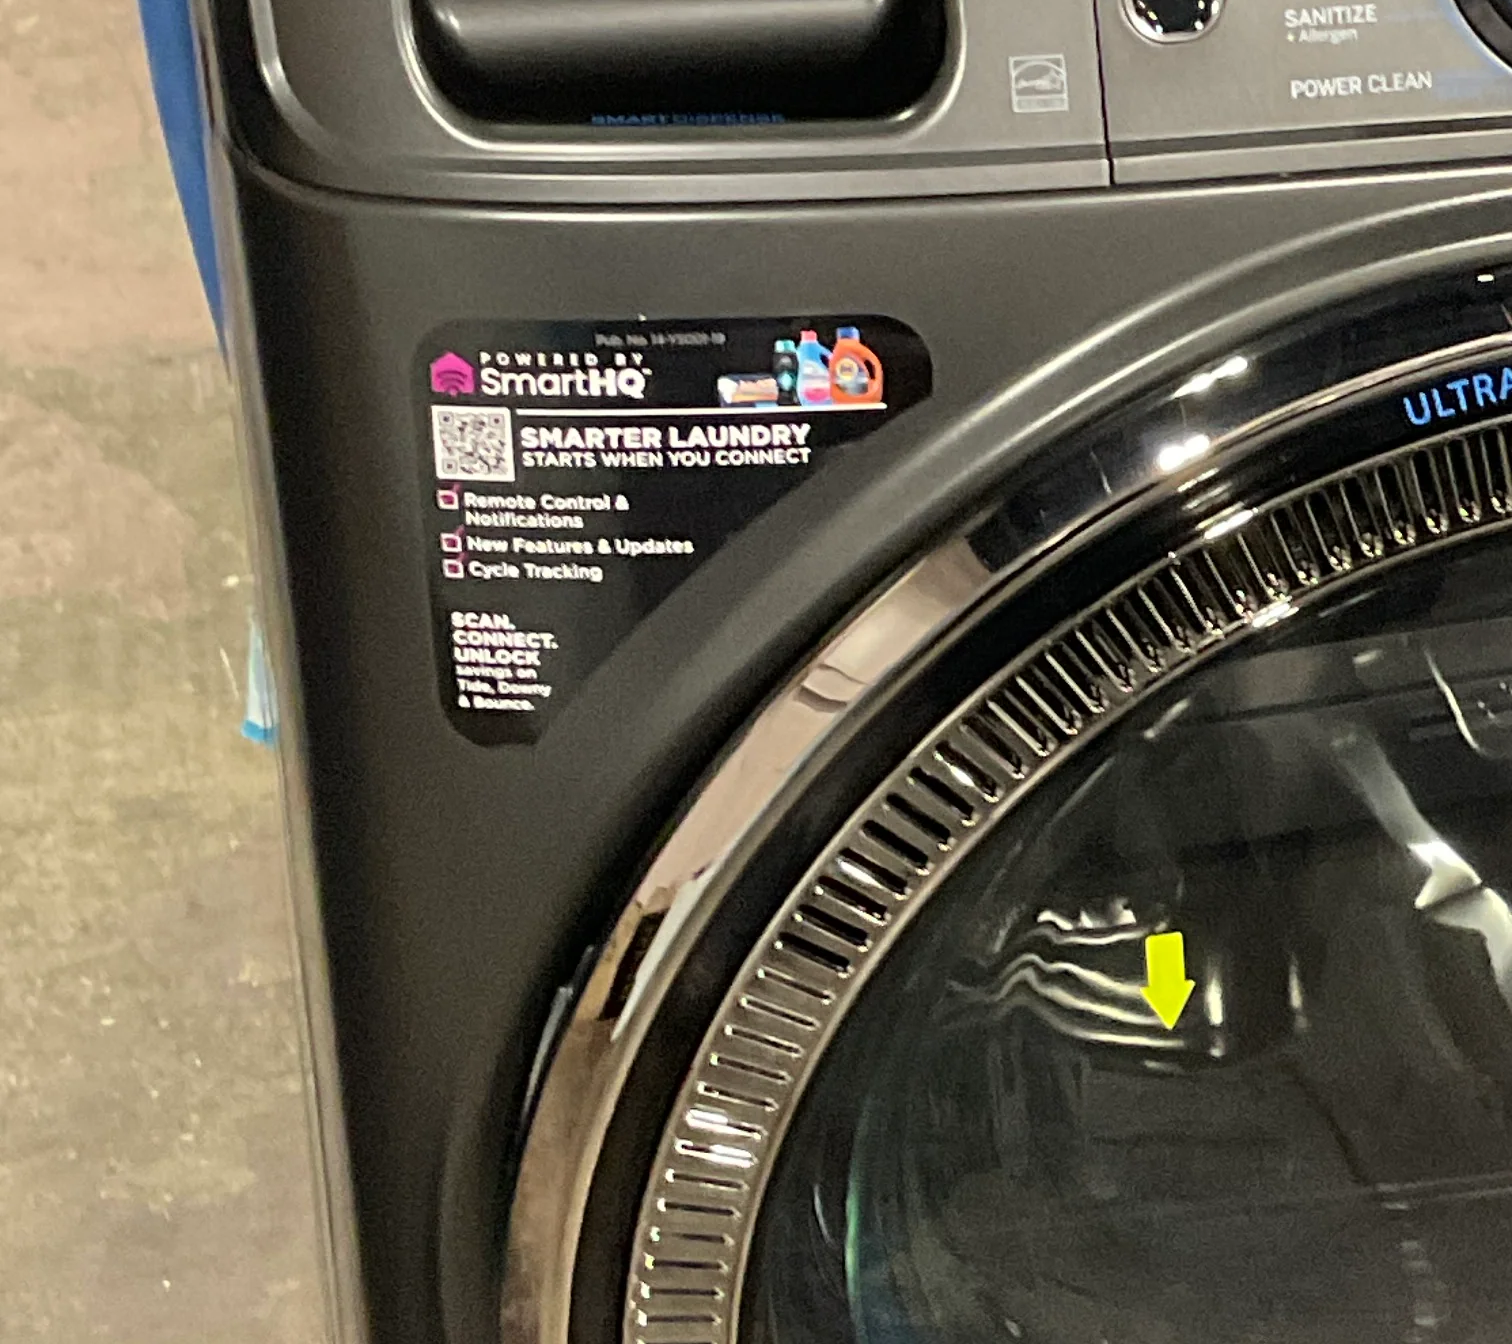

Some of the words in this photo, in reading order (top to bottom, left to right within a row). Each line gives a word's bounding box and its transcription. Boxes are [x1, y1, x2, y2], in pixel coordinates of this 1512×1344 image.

[1284, 3, 1378, 29] SANITIZE
[1290, 75, 1363, 100] POWER
[1367, 70, 1434, 94] CLEAN
[480, 352, 600, 366] POWERED
[614, 353, 644, 366] BY
[480, 368, 648, 398] SmartHQ
[520, 426, 662, 449] SMARTER
[668, 423, 811, 449] LAUNDRY
[522, 451, 597, 467] STARTS
[601, 451, 664, 467] WHEN
[667, 450, 711, 467] YOU
[715, 447, 812, 466] CONNECT
[463, 492, 536, 510] Remote
[540, 493, 611, 511] Control
[614, 495, 630, 511] &
[465, 511, 584, 529] Notifications
[466, 536, 508, 553] New
[512, 537, 593, 554] Features
[597, 539, 612, 554] &
[614, 538, 695, 557] Updates
[468, 561, 519, 579] Cycle
[523, 563, 604, 583] Tracking
[451, 611, 516, 630] SCAN.
[452, 630, 559, 649] CONNECT.
[454, 647, 541, 666] UNLOCK
